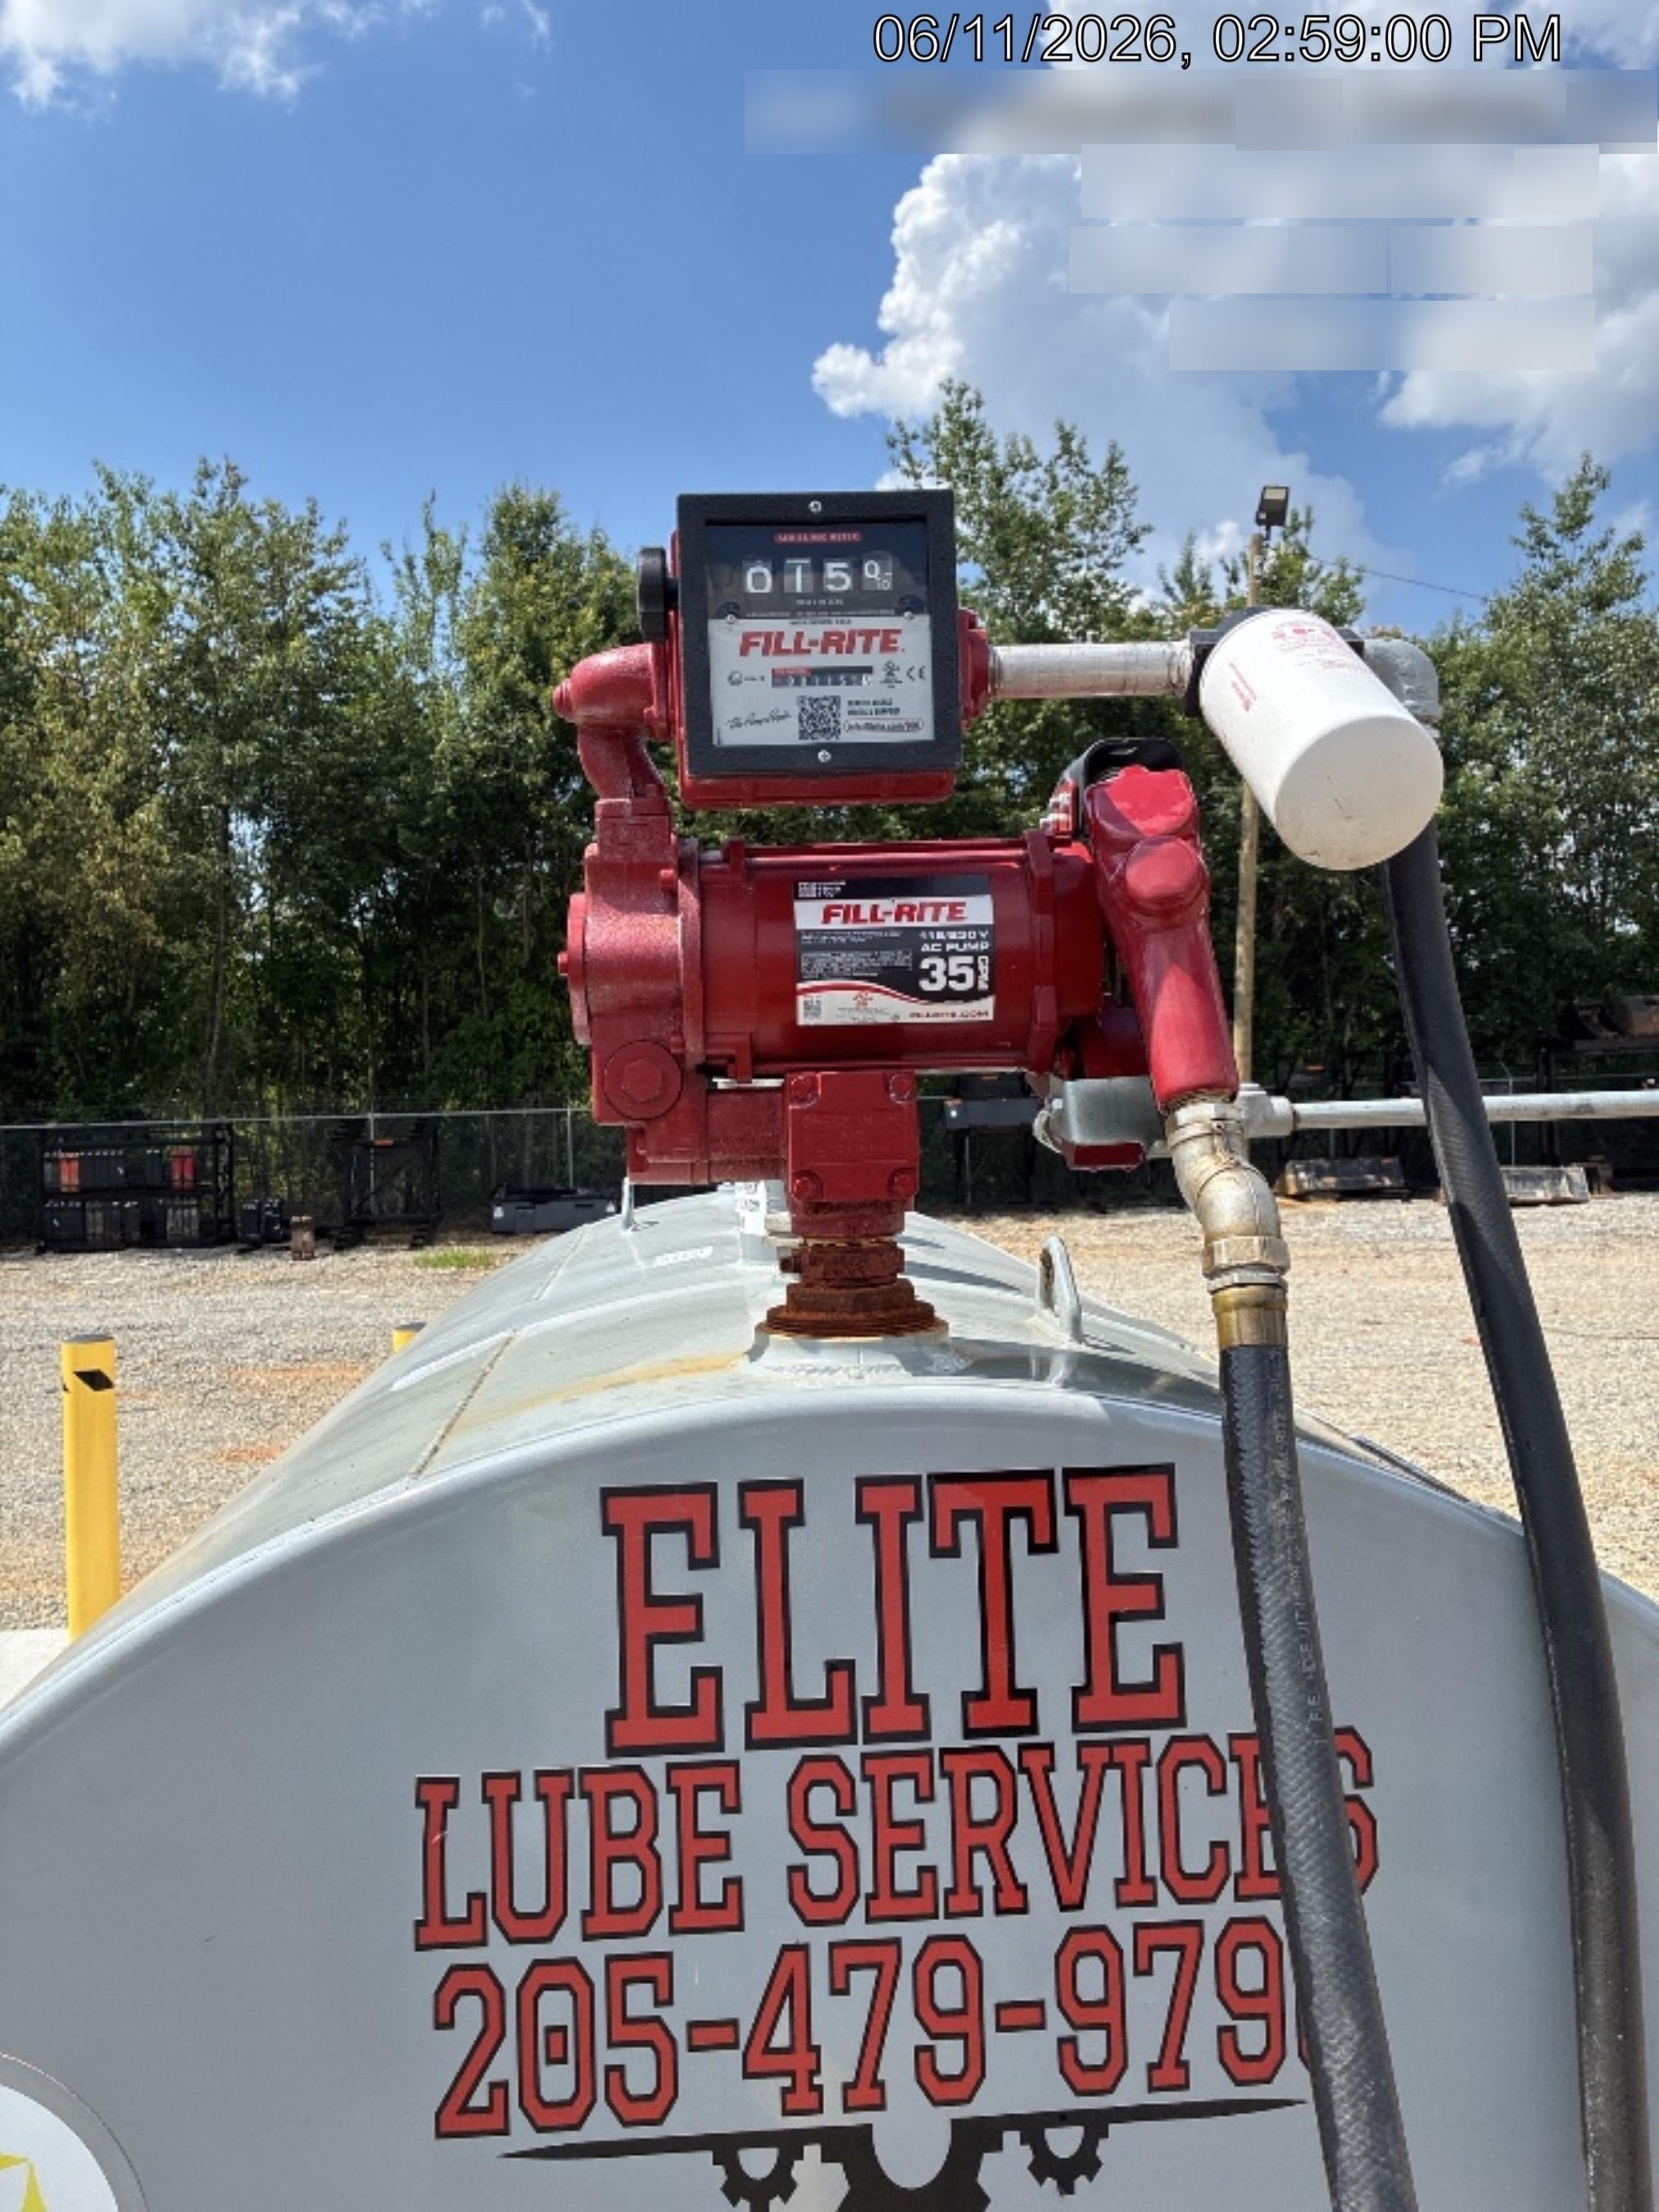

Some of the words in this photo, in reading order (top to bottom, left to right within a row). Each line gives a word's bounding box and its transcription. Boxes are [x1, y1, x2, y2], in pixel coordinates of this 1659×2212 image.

[739, 628, 902, 656] FILL-RITE
[821, 901, 968, 925] FILL-RITE
[945, 941, 990, 952] PUMP
[918, 955, 975, 991] 35
[600, 1462, 1187, 1759] ELITE
[414, 1760, 745, 1951] LUBE
[433, 1915, 1312, 2140] 205-479-979
